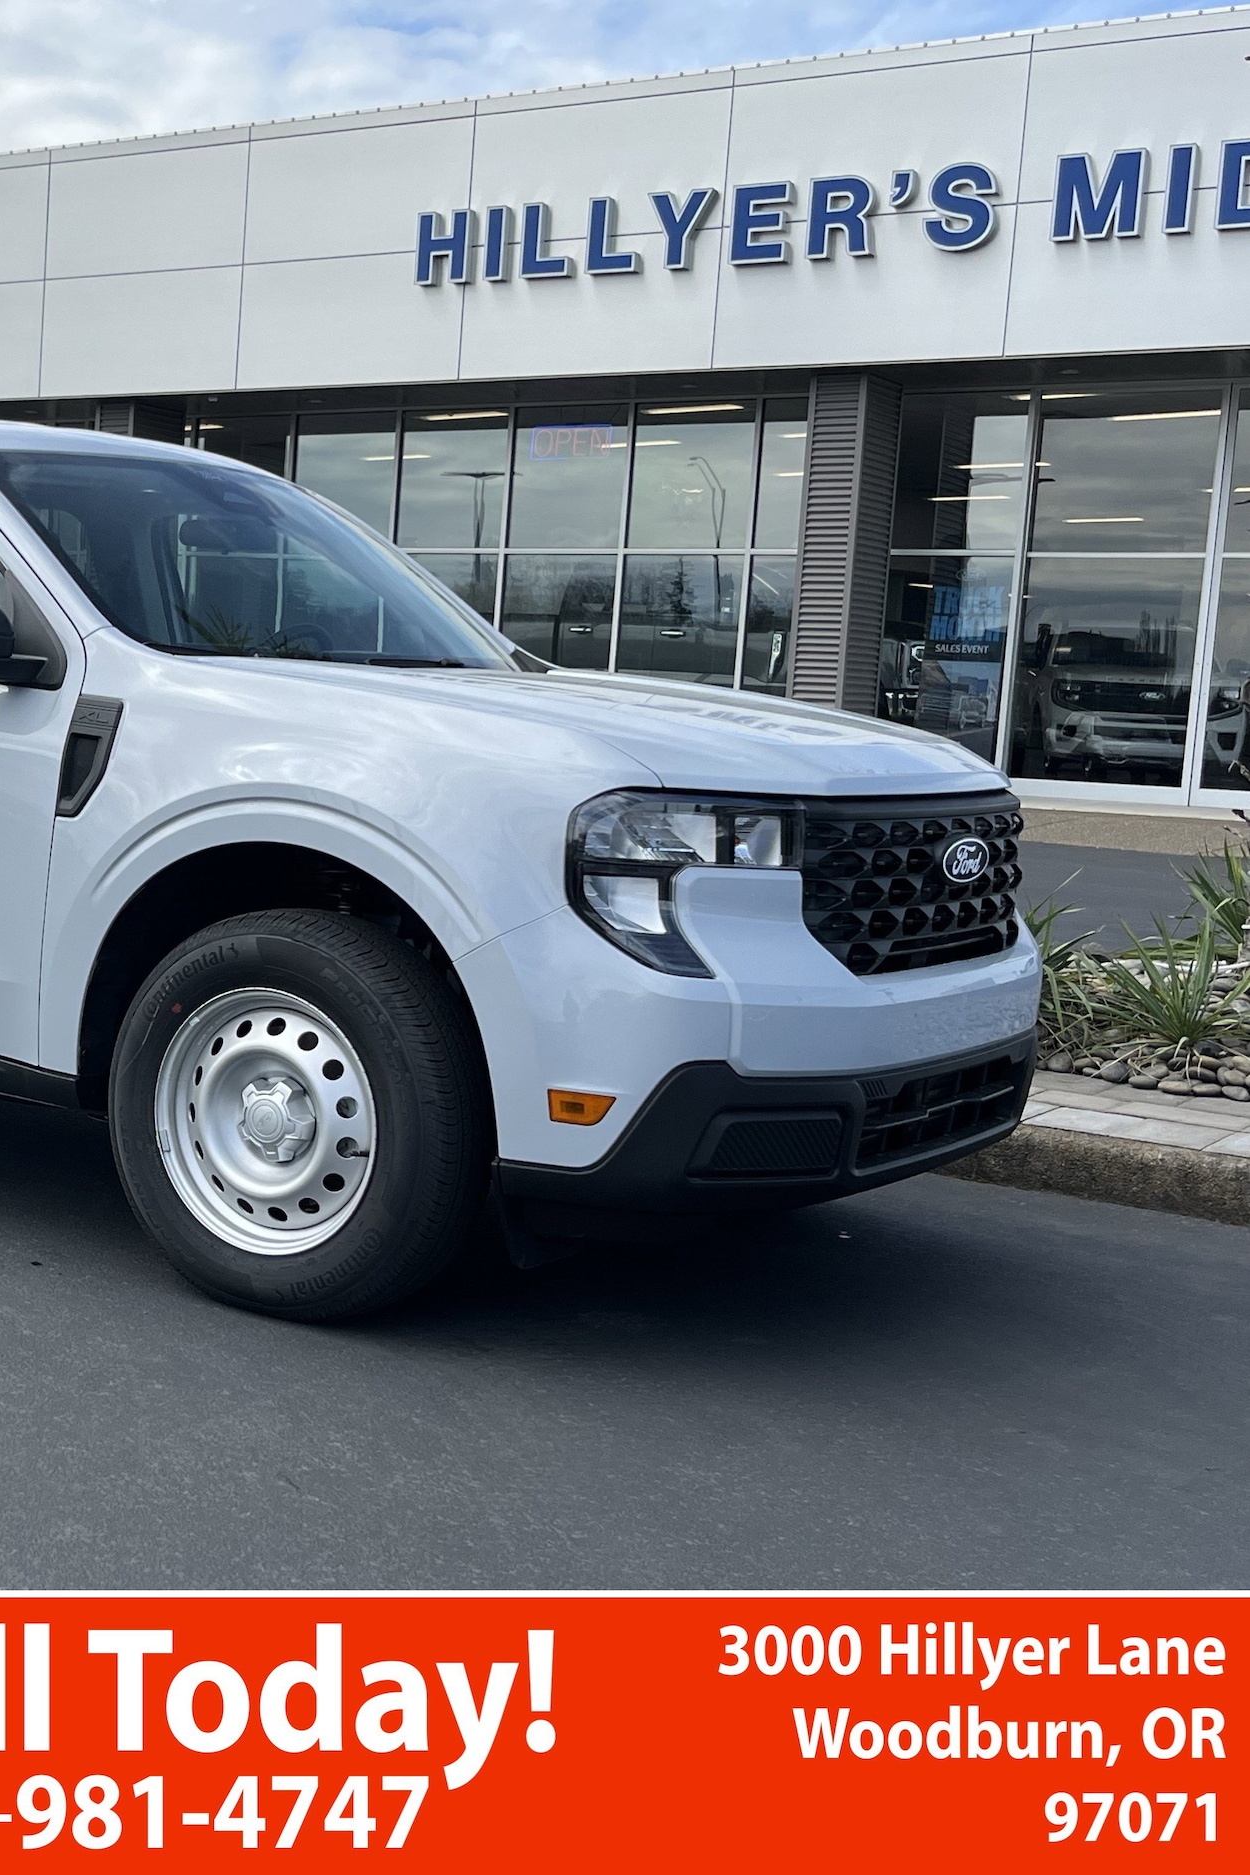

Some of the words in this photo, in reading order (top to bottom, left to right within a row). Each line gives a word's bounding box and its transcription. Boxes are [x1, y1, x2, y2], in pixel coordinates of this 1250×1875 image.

[414, 161, 999, 287] HILLYER'S
[535, 428, 610, 457] OPEN
[935, 644, 961, 653] SALES
[961, 644, 989, 654] EVENT
[952, 844, 982, 875] Ford
[143, 945, 225, 1022] Continental
